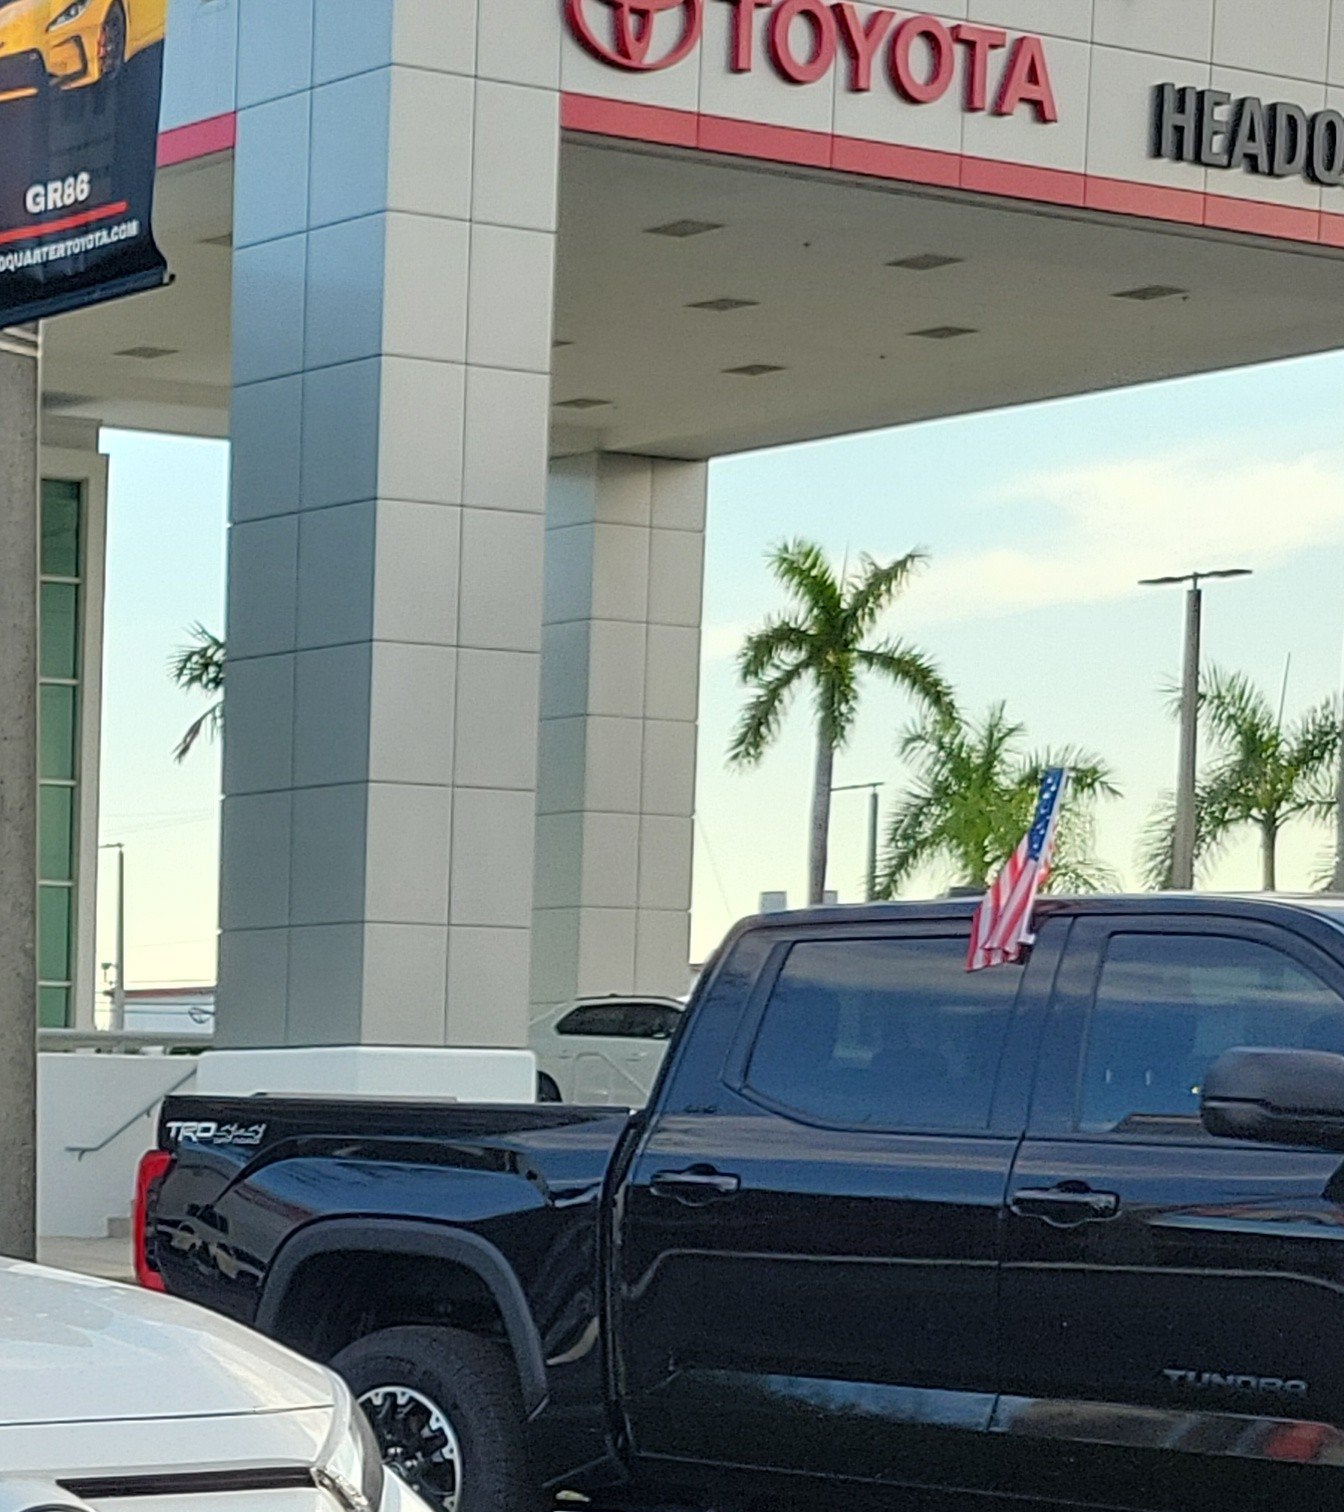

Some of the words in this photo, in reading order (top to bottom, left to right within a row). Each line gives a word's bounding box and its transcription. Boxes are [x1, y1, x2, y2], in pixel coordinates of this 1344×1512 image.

[720, 0, 1058, 124] TOYOTA
[25, 171, 91, 213] GR86
[166, 1121, 217, 1143] TRD
[1162, 1368, 1310, 1394] TUNDRA
